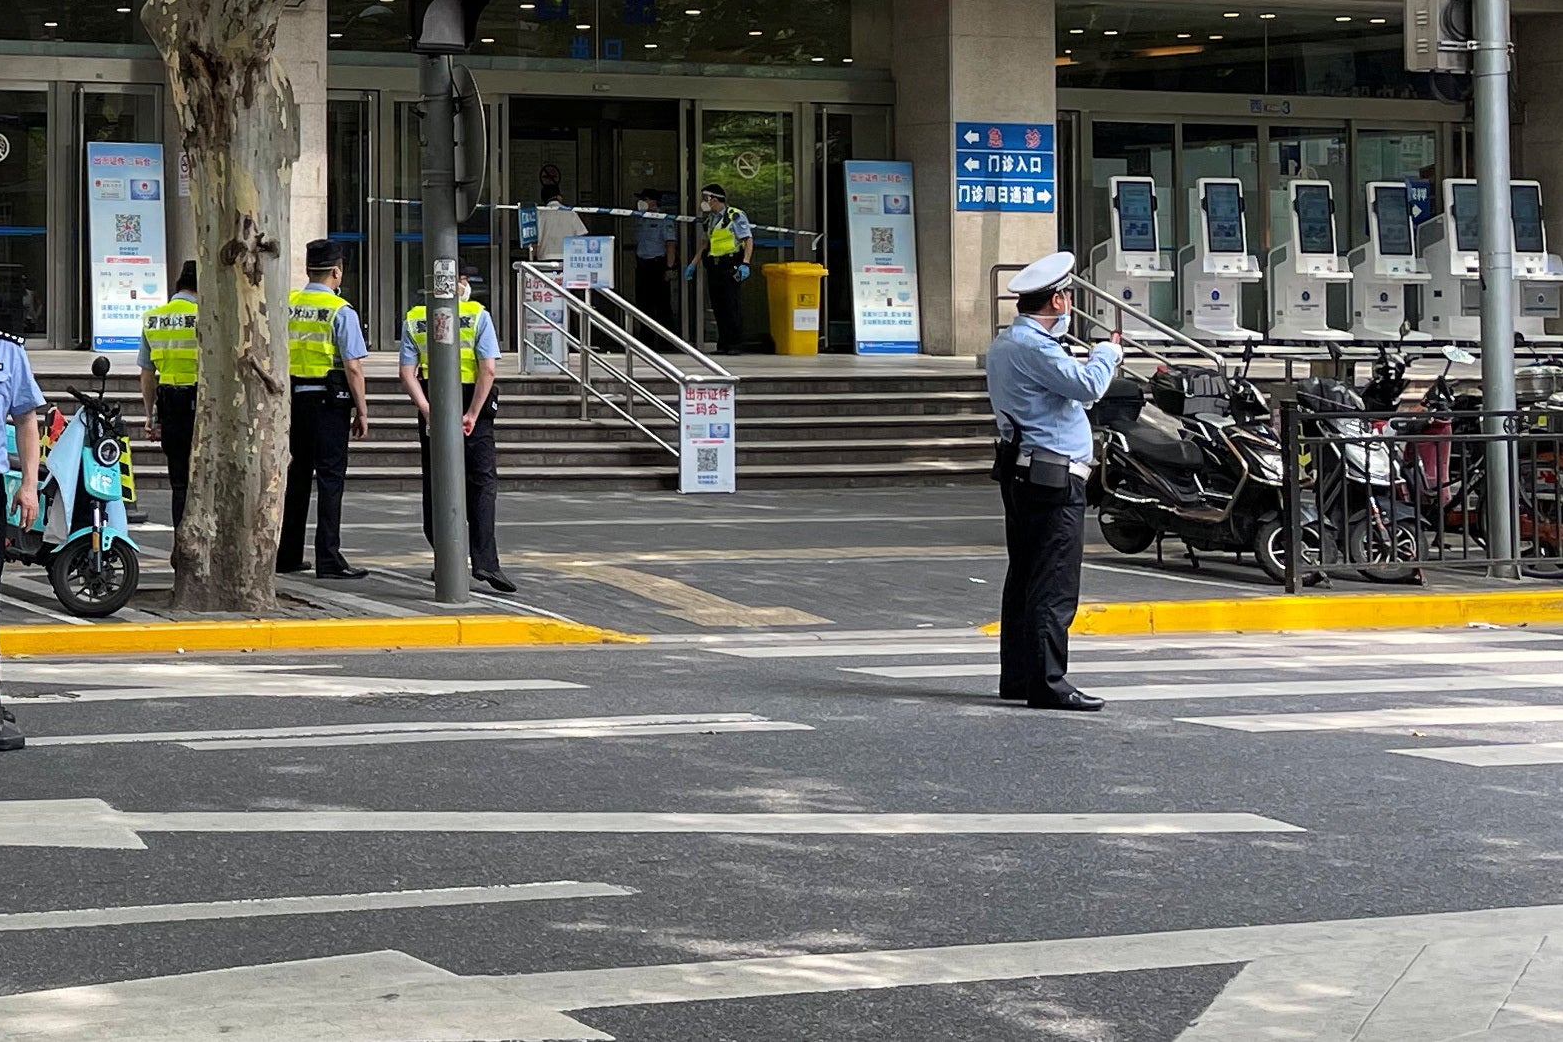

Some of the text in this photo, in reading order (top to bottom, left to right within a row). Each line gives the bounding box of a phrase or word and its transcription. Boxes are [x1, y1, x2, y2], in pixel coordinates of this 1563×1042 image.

[987, 127, 1041, 148] 急诊
[988, 155, 1041, 173] 门诊入口
[959, 185, 1034, 204] 门诊周日通道
[159, 317, 183, 327] POLICE
[685, 388, 729, 401] 出示证件
[685, 403, 730, 415] 二码合一
